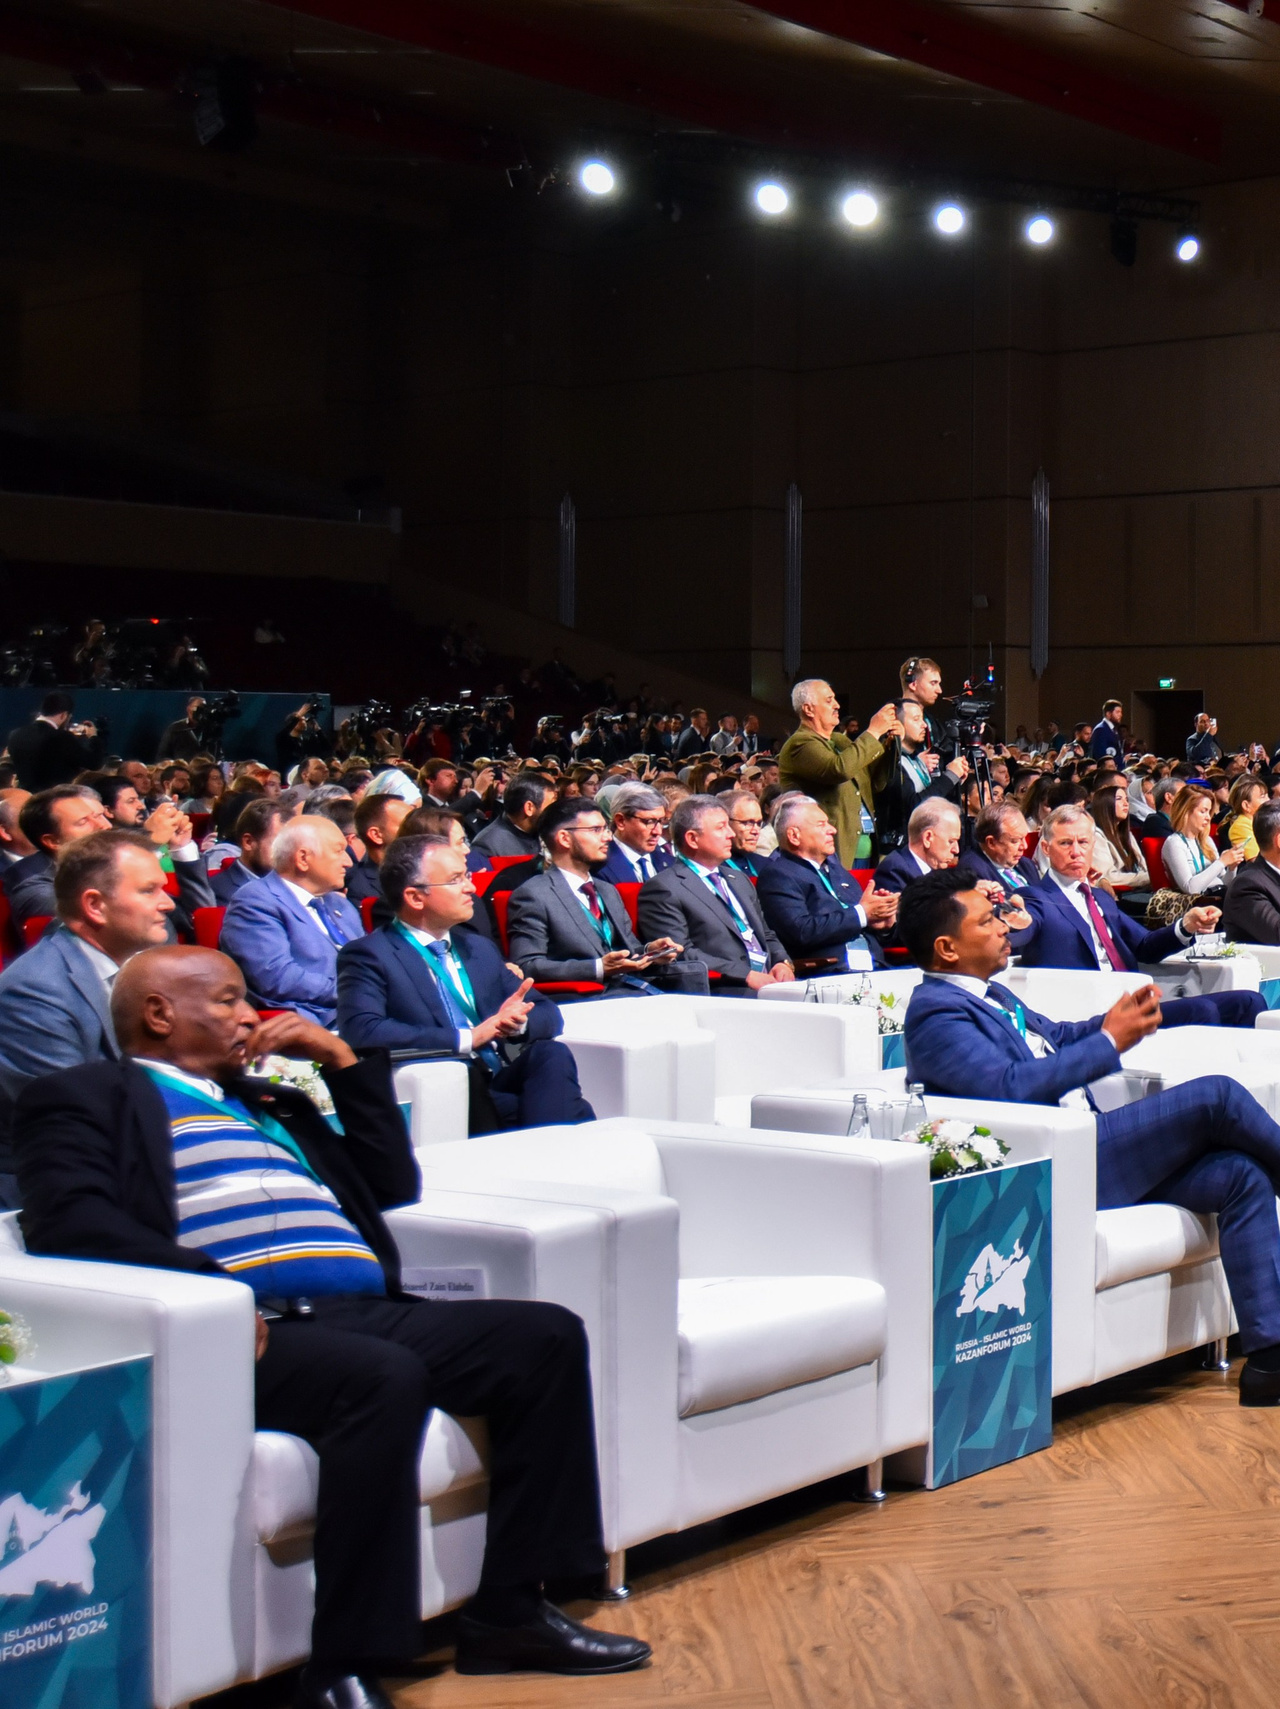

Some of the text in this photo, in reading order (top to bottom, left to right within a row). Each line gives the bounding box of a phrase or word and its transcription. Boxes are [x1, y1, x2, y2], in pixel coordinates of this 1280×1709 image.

[955, 1338, 978, 1352] RUSSIA
[983, 1329, 1008, 1343] ISLAMIC
[1008, 1322, 1032, 1335] WORLD
[955, 1332, 1032, 1364] KAZANFORUM 2024
[0, 1617, 109, 1662] FORUM 2024
[4, 1602, 109, 1643] ISLAMIC WORLD
